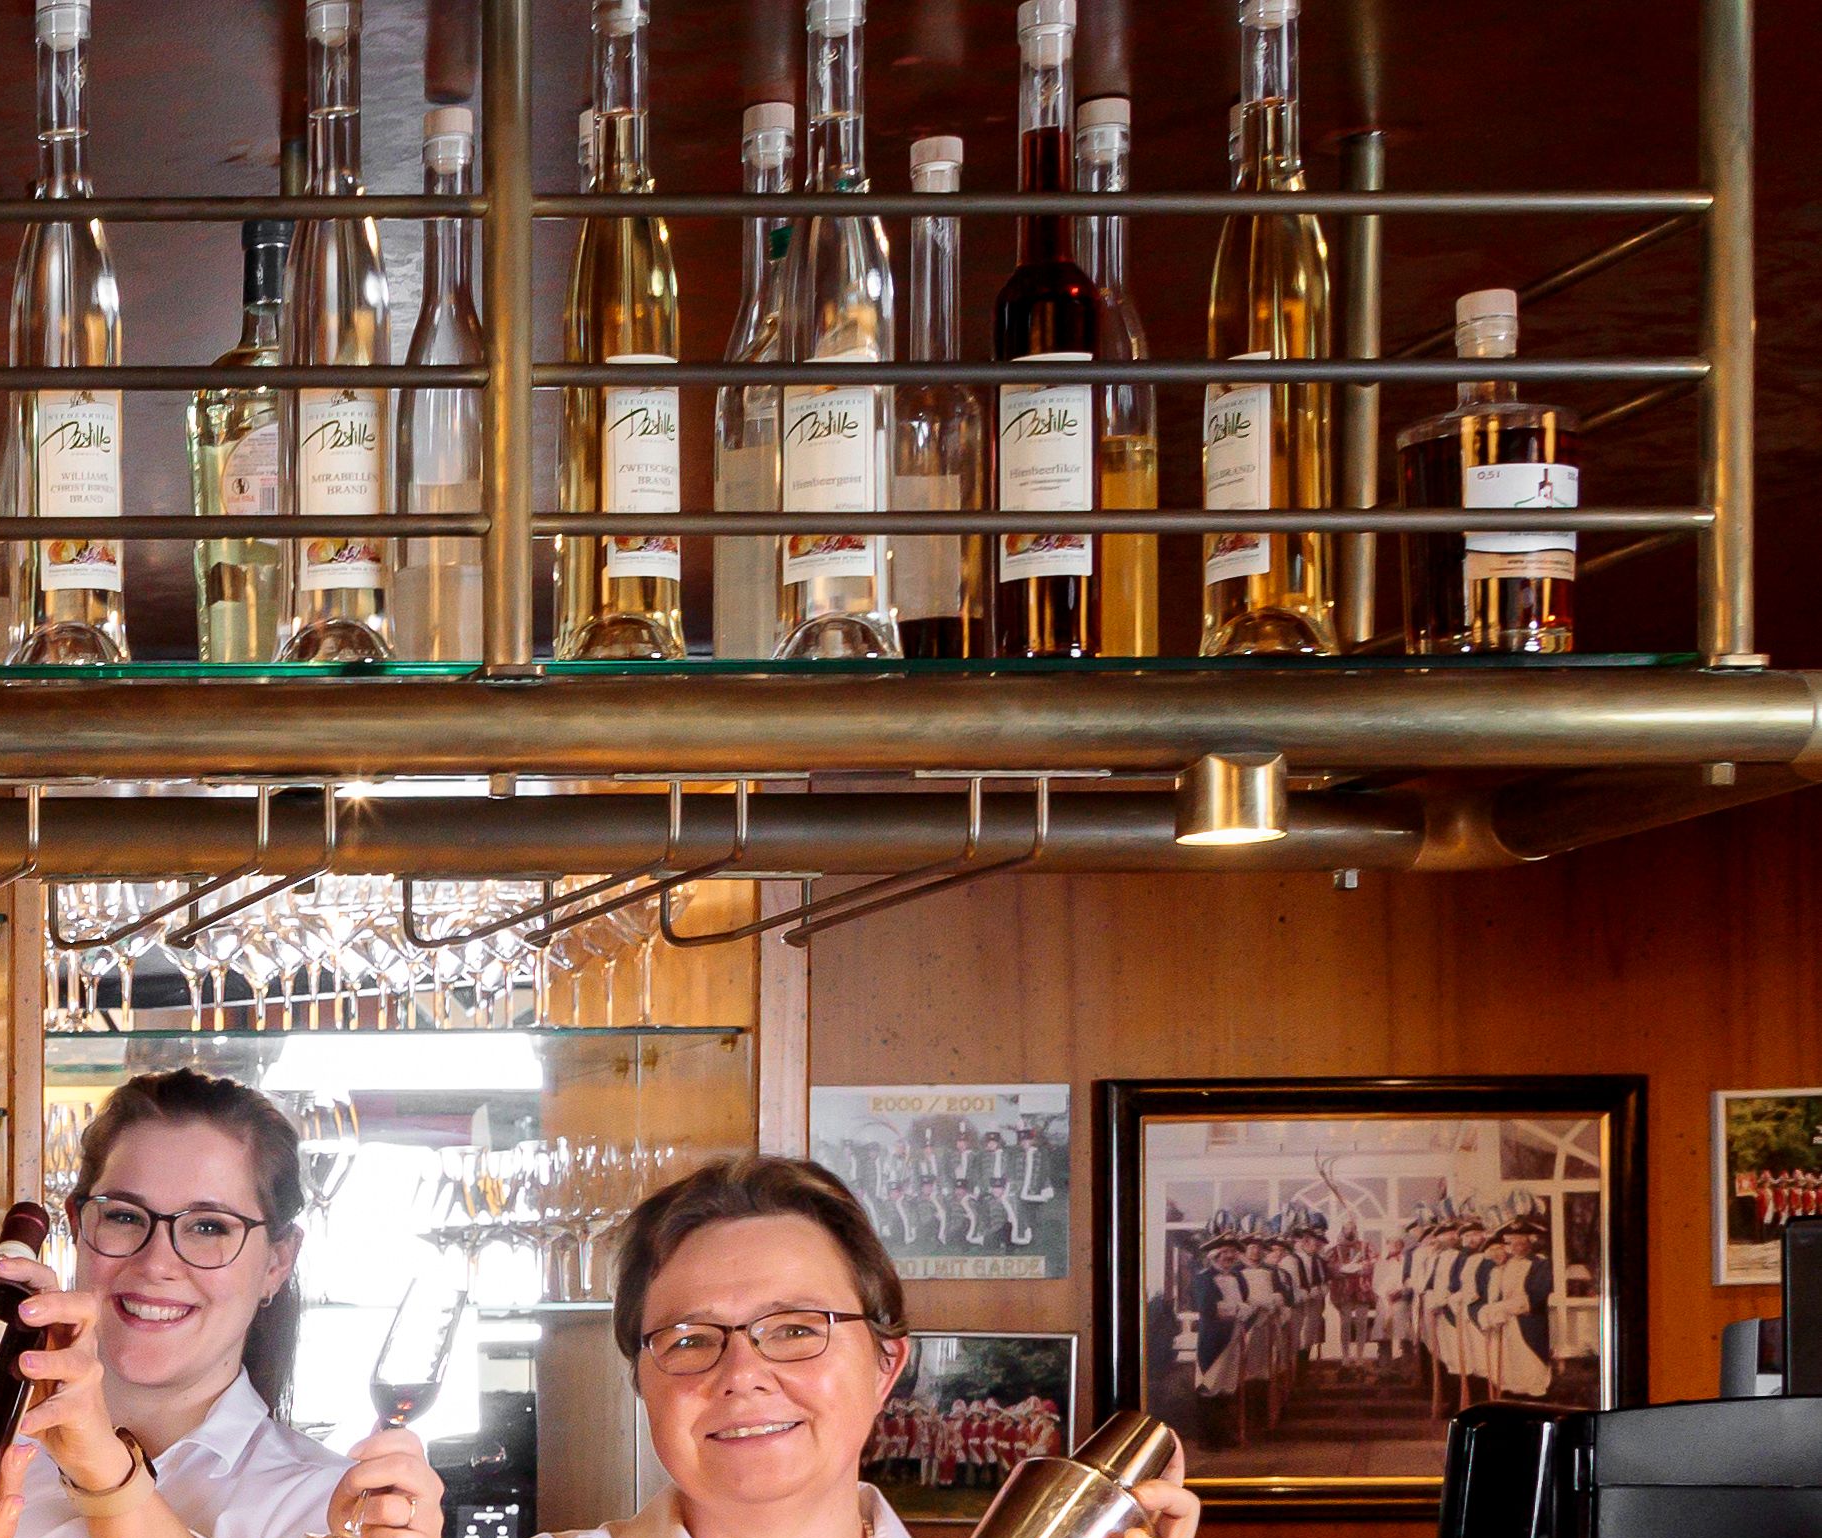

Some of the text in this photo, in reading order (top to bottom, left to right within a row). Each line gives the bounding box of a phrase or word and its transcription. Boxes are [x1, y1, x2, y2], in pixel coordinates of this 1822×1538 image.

[61, 472, 109, 482] WILLIAMS
[637, 476, 671, 487] BRAND
[326, 485, 368, 496] BRAND
[69, 493, 105, 504] BRAND
[871, 1096, 923, 1112] 2000
[946, 1096, 996, 1112] 2001
